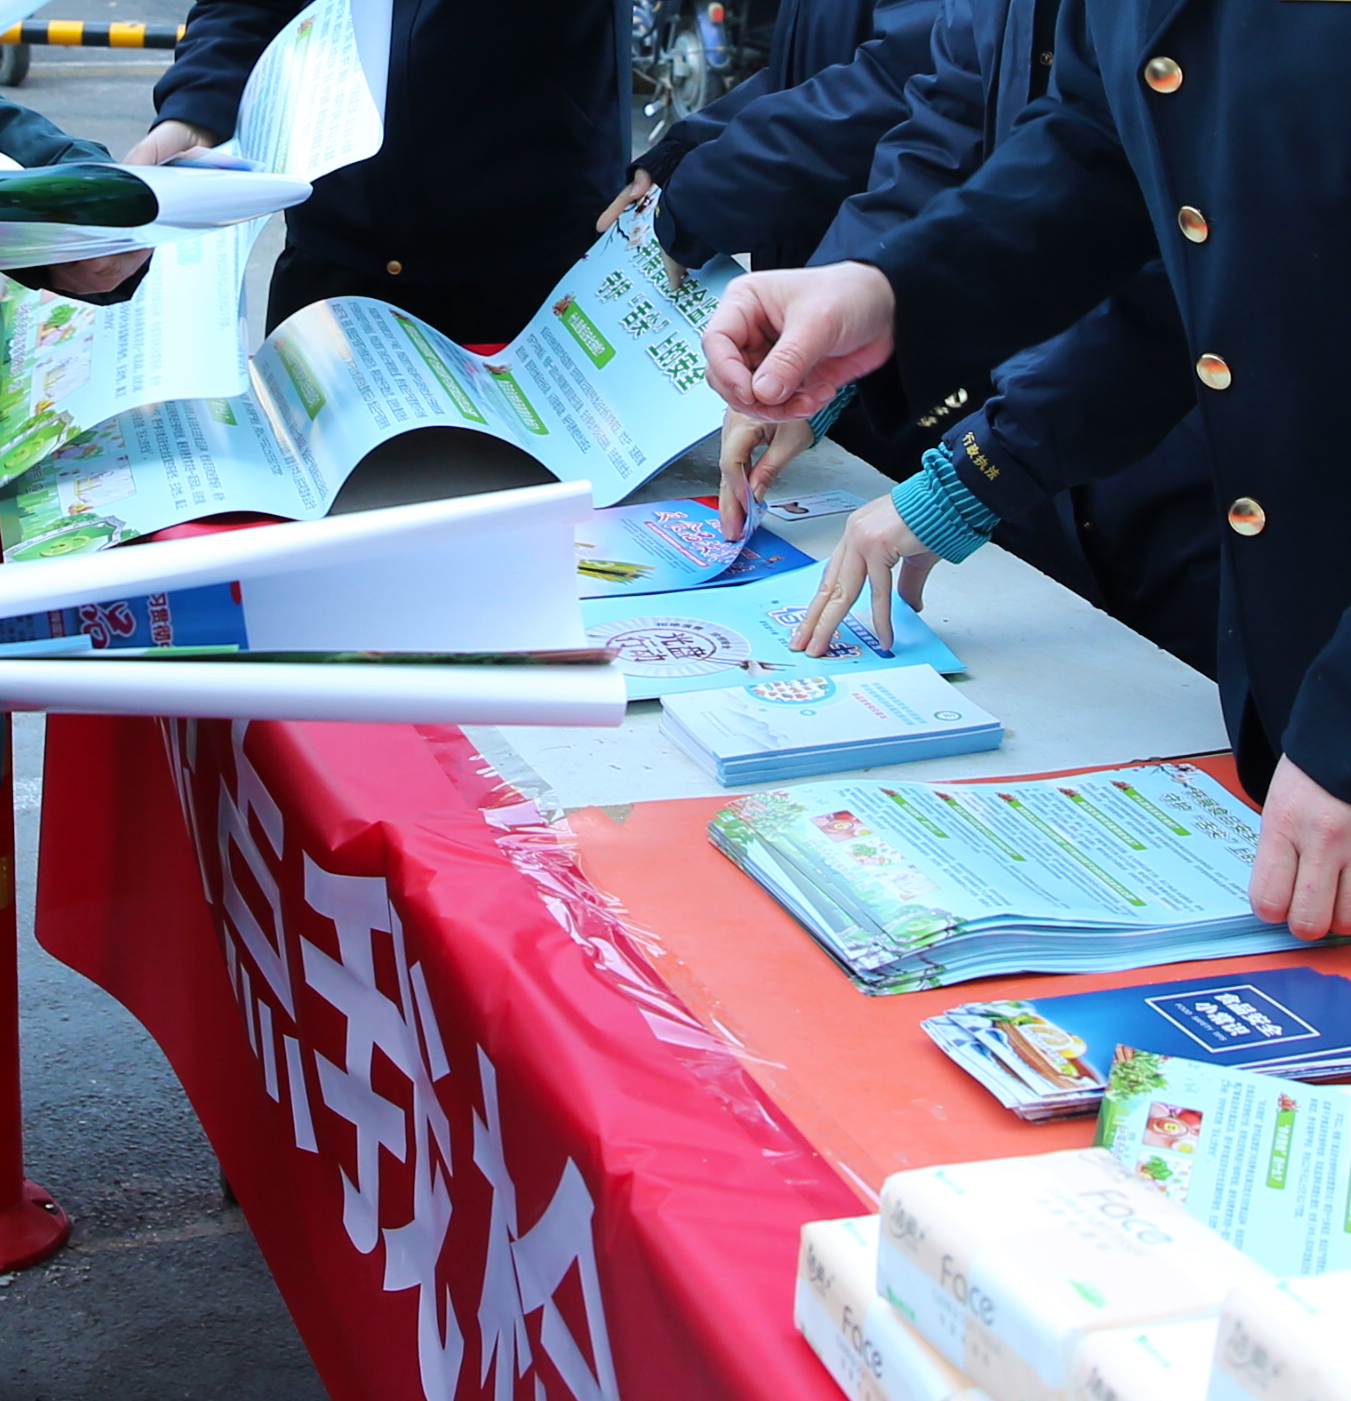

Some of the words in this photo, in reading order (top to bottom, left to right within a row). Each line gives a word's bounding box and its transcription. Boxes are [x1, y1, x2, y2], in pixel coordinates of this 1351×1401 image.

[148, 592, 173, 648] 习贯彻
[615, 635, 667, 662] 行动
[653, 630, 709, 660] 光盘
[1195, 1001, 1251, 1037] 小常识
[1213, 992, 1283, 1038] 食品安全
[939, 1253, 996, 1328] Face
[841, 1303, 884, 1381] Face
